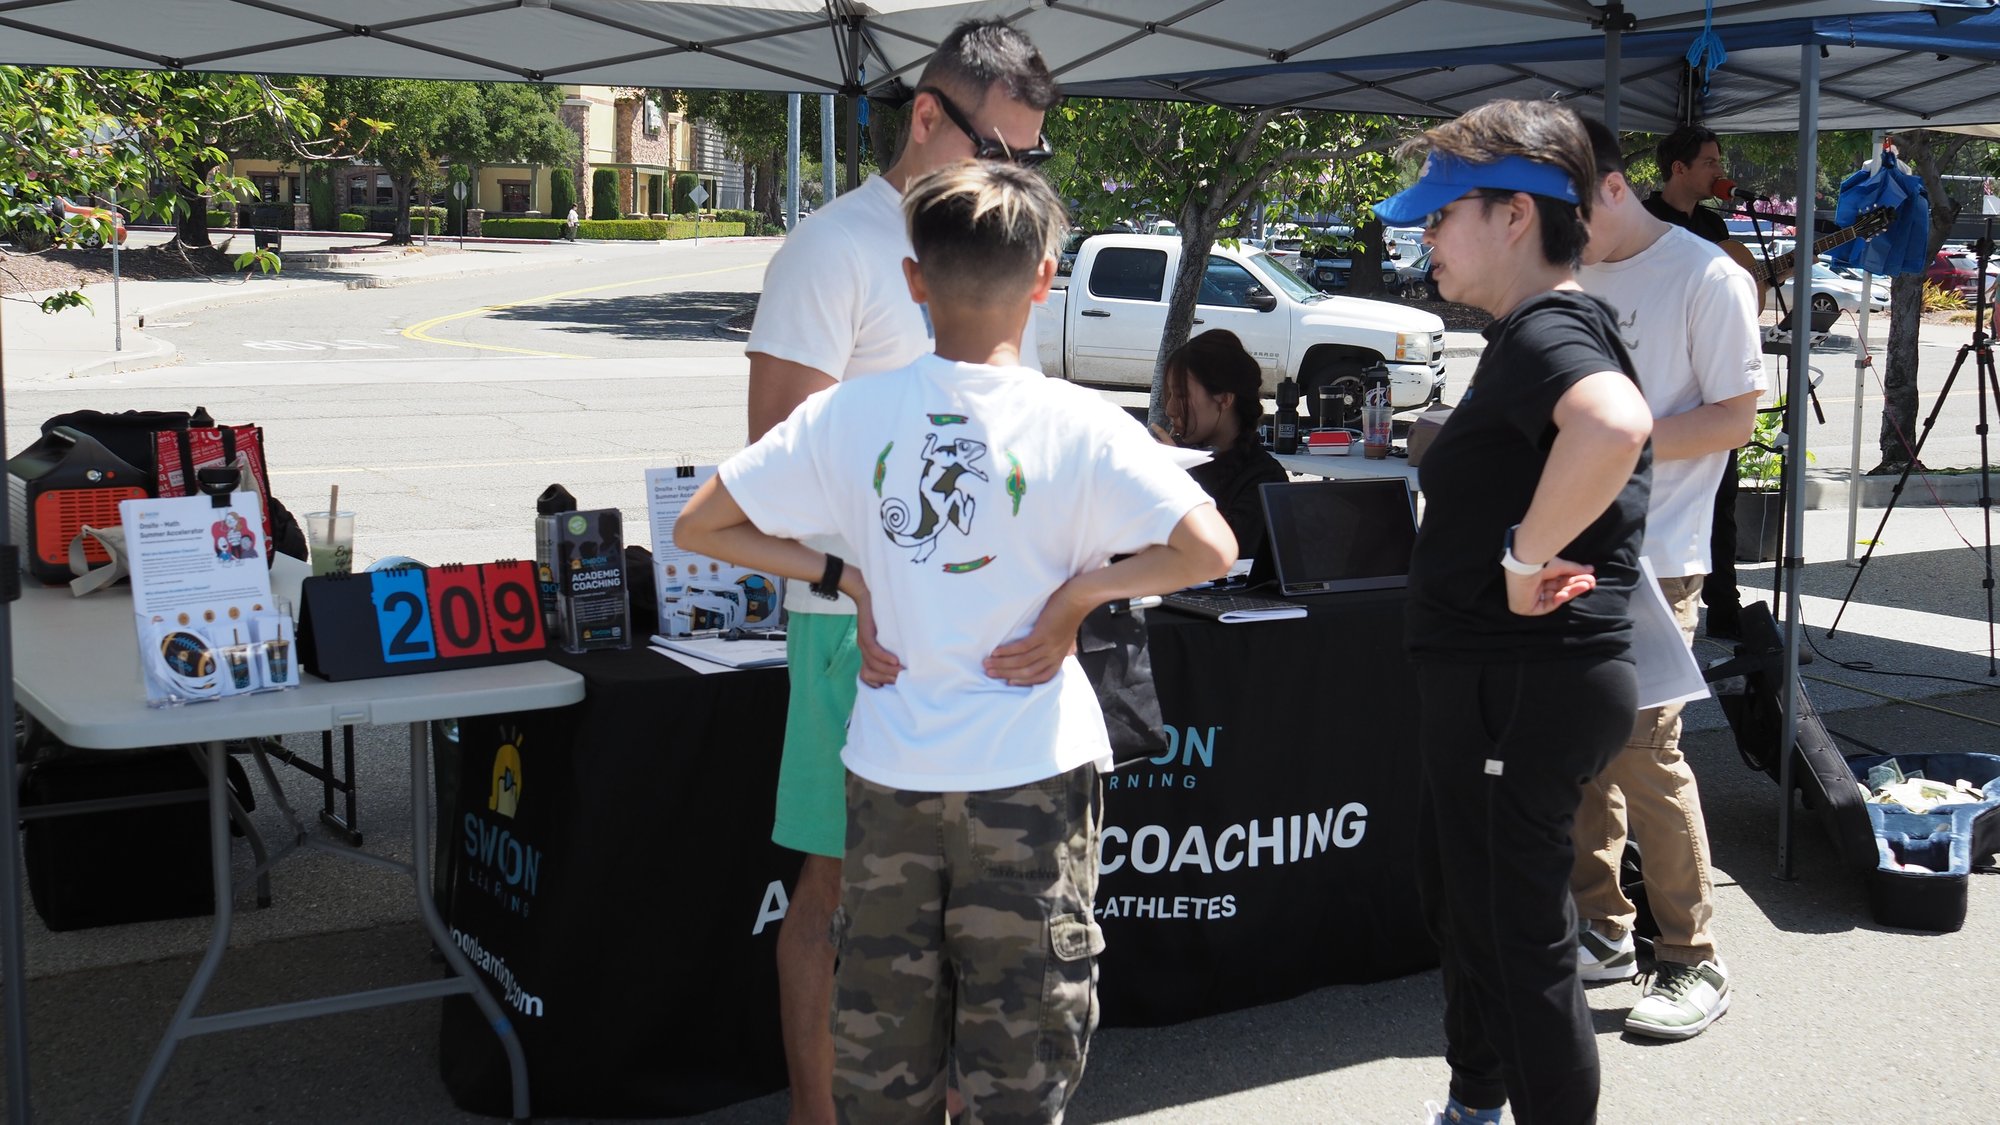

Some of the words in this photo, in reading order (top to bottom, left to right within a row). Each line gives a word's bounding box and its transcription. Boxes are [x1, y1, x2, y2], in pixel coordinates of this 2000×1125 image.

[164, 520, 180, 528] Math
[140, 530, 166, 538] Summer
[571, 568, 620, 583] ACADEMIC
[572, 577, 621, 592] COACHING
[1109, 773, 1197, 790] RNING
[1099, 802, 1368, 875] COACHING
[465, 812, 541, 896] SWOON
[1094, 894, 1237, 920] -ATHLETES
